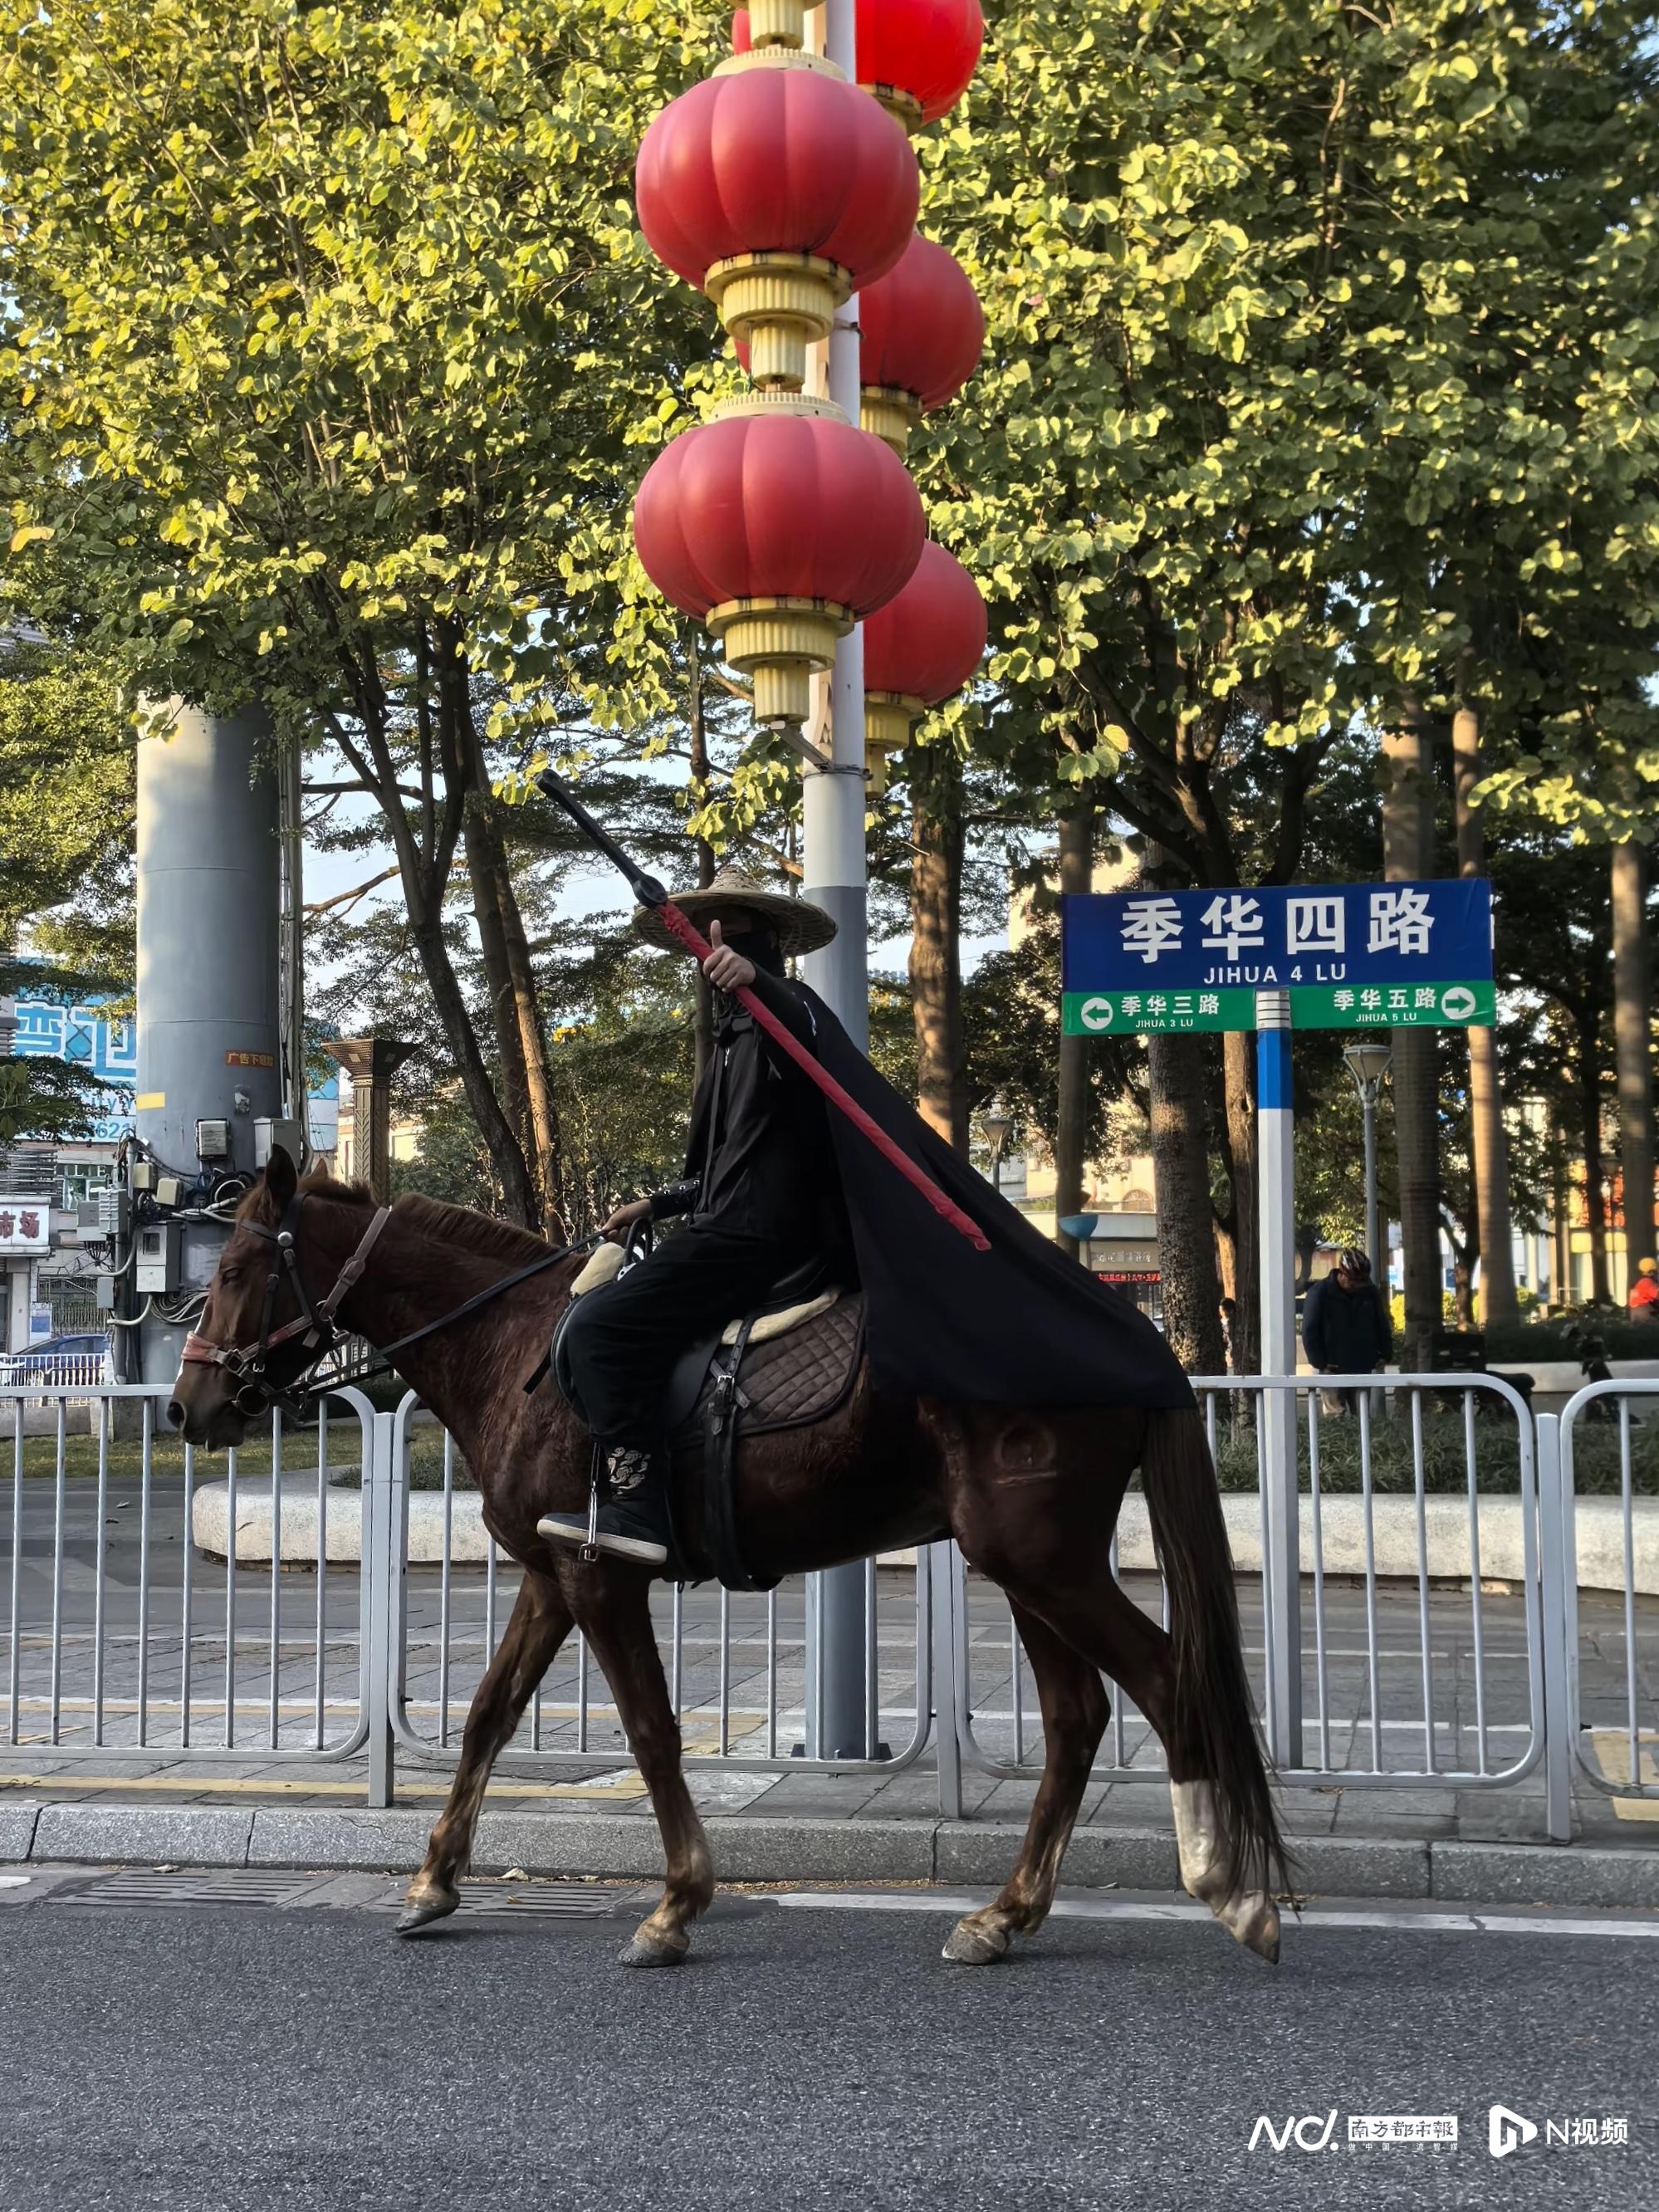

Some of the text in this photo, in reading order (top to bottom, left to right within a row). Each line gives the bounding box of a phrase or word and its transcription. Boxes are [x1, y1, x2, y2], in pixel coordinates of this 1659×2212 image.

[1120, 888, 1435, 963] 季华四路
[1204, 964, 1346, 984] JIHUA 4 LU
[1121, 996, 1220, 1016] 季华三路
[1334, 987, 1436, 1011] 季华五路
[1135, 1018, 1193, 1028] JIHUA 3 LU
[1355, 1012, 1417, 1023] JIHUA 5 LU
